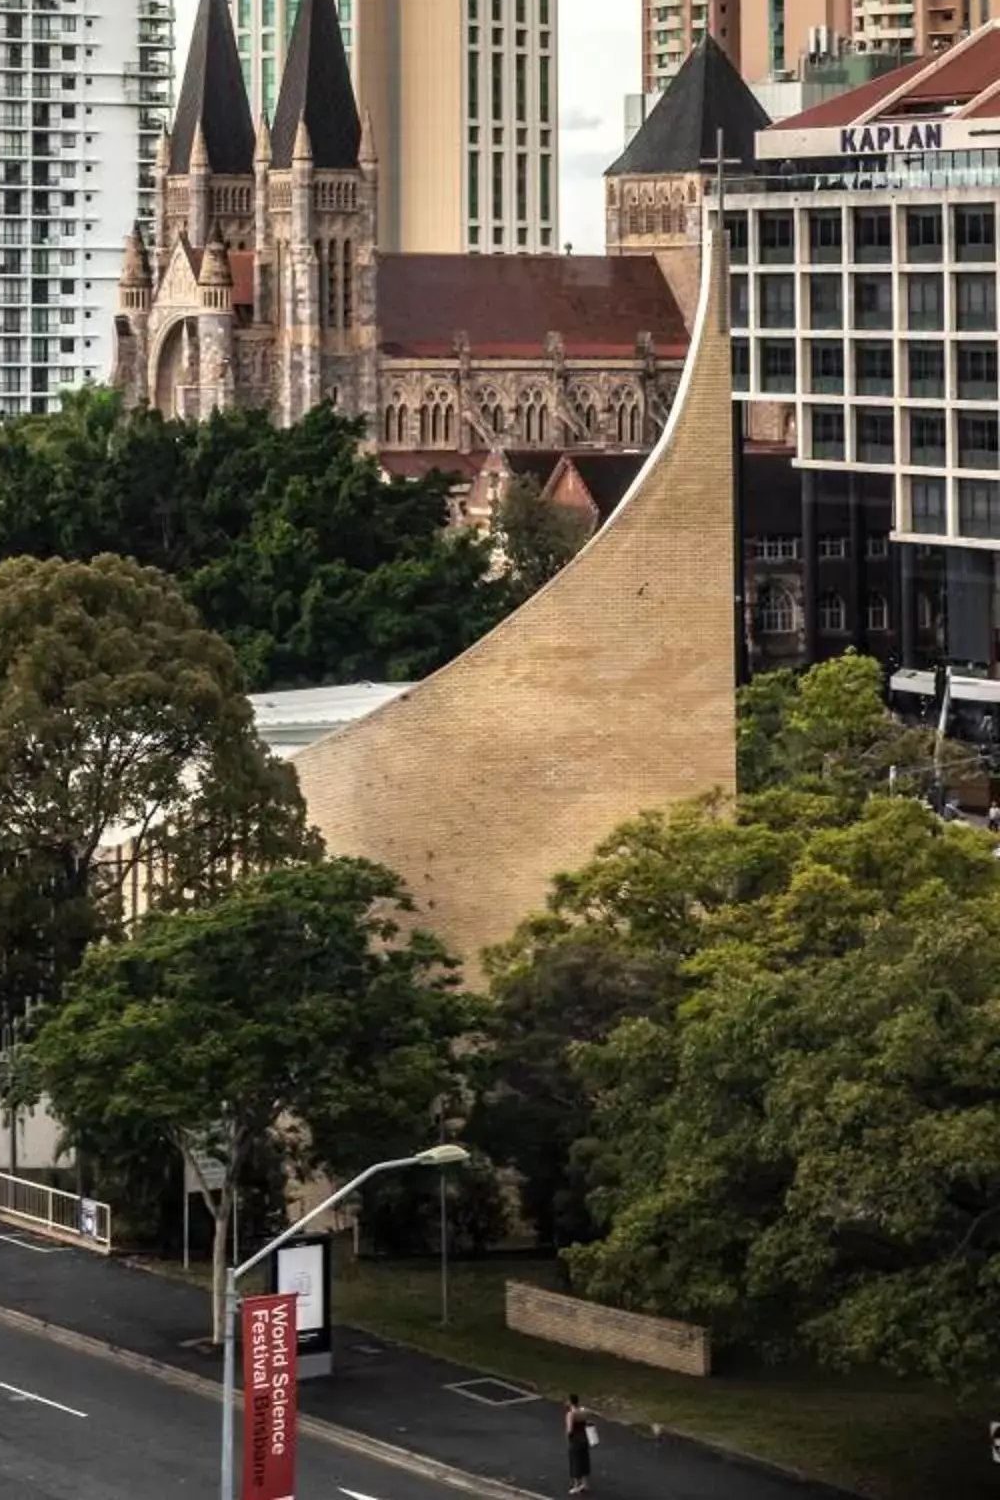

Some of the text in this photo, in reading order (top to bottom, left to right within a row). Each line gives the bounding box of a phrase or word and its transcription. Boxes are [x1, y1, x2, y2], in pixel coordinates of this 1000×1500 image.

[841, 124, 941, 152] KAPLAN
[252, 1309, 270, 1488] Festival Brisbane
[271, 1304, 289, 1455] World Science
